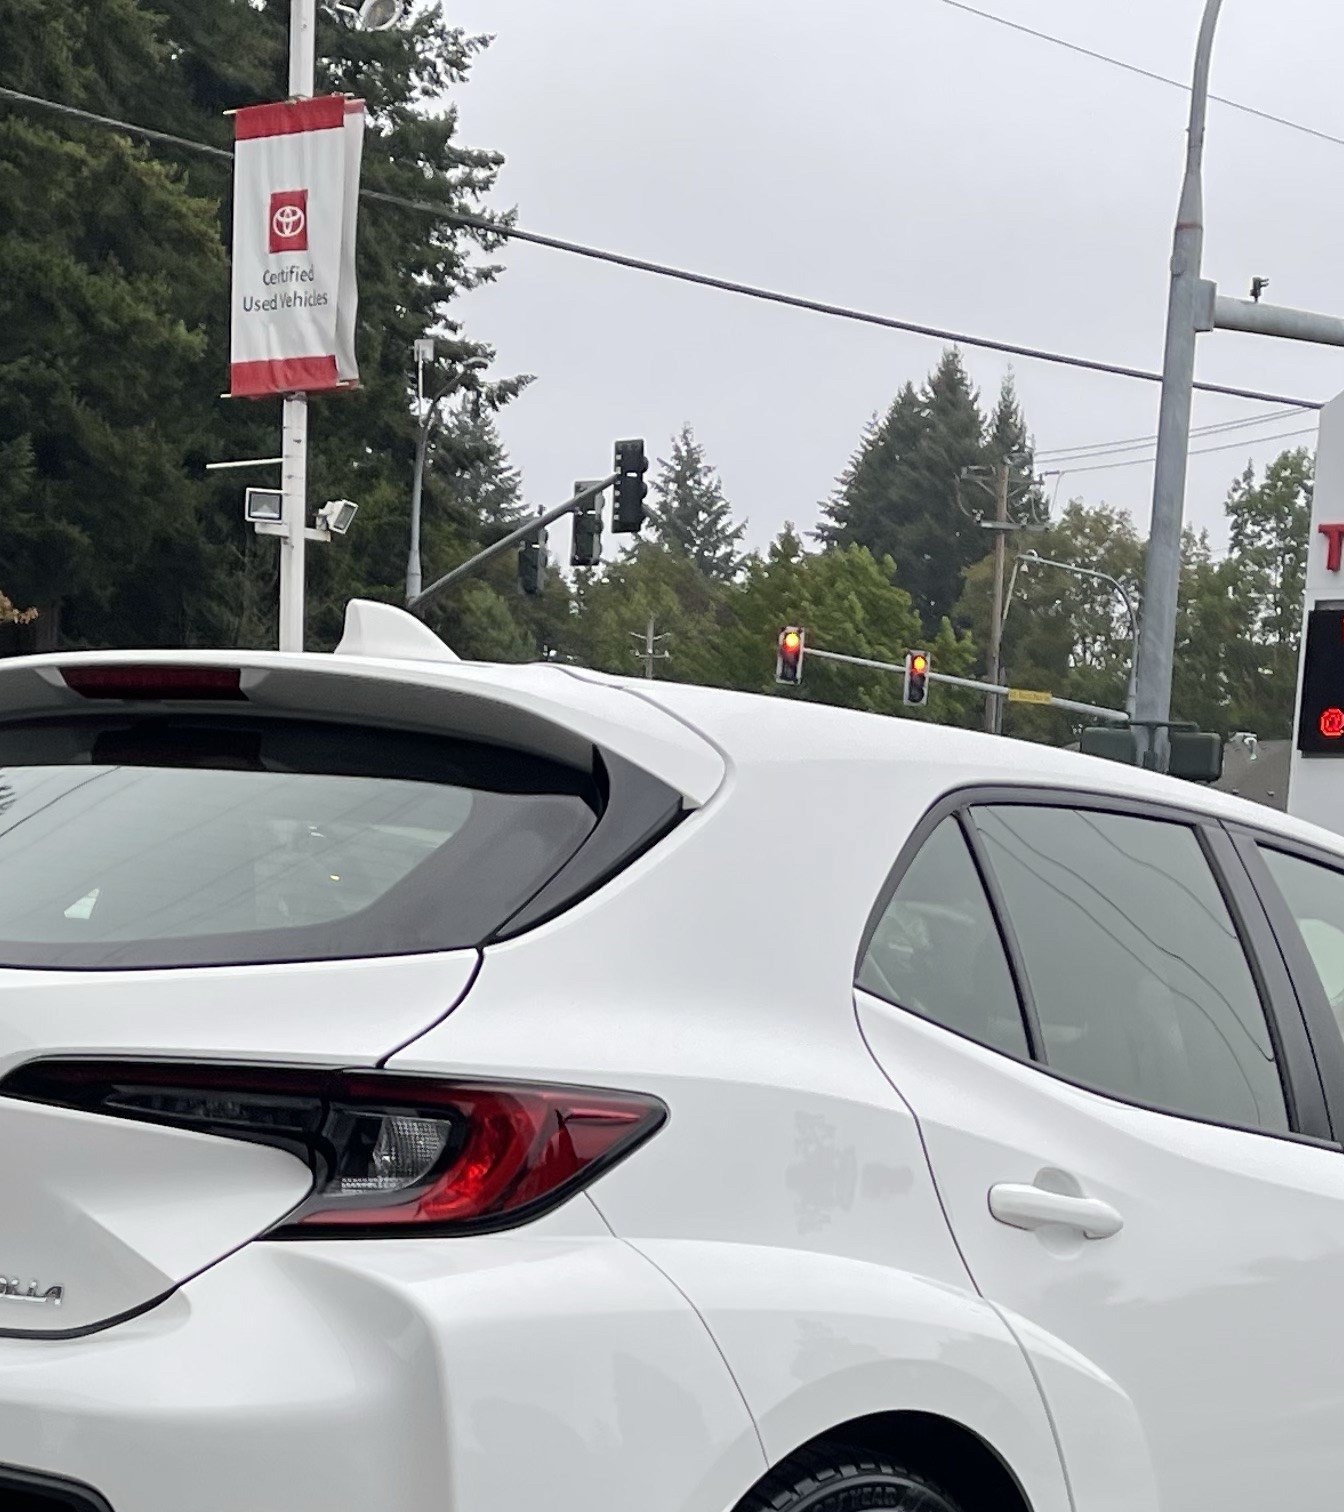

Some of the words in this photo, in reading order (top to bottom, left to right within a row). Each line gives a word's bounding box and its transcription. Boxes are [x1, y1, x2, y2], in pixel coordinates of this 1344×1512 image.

[262, 263, 315, 286] Certified
[242, 292, 278, 313] Used
[279, 290, 328, 309] Vehicles
